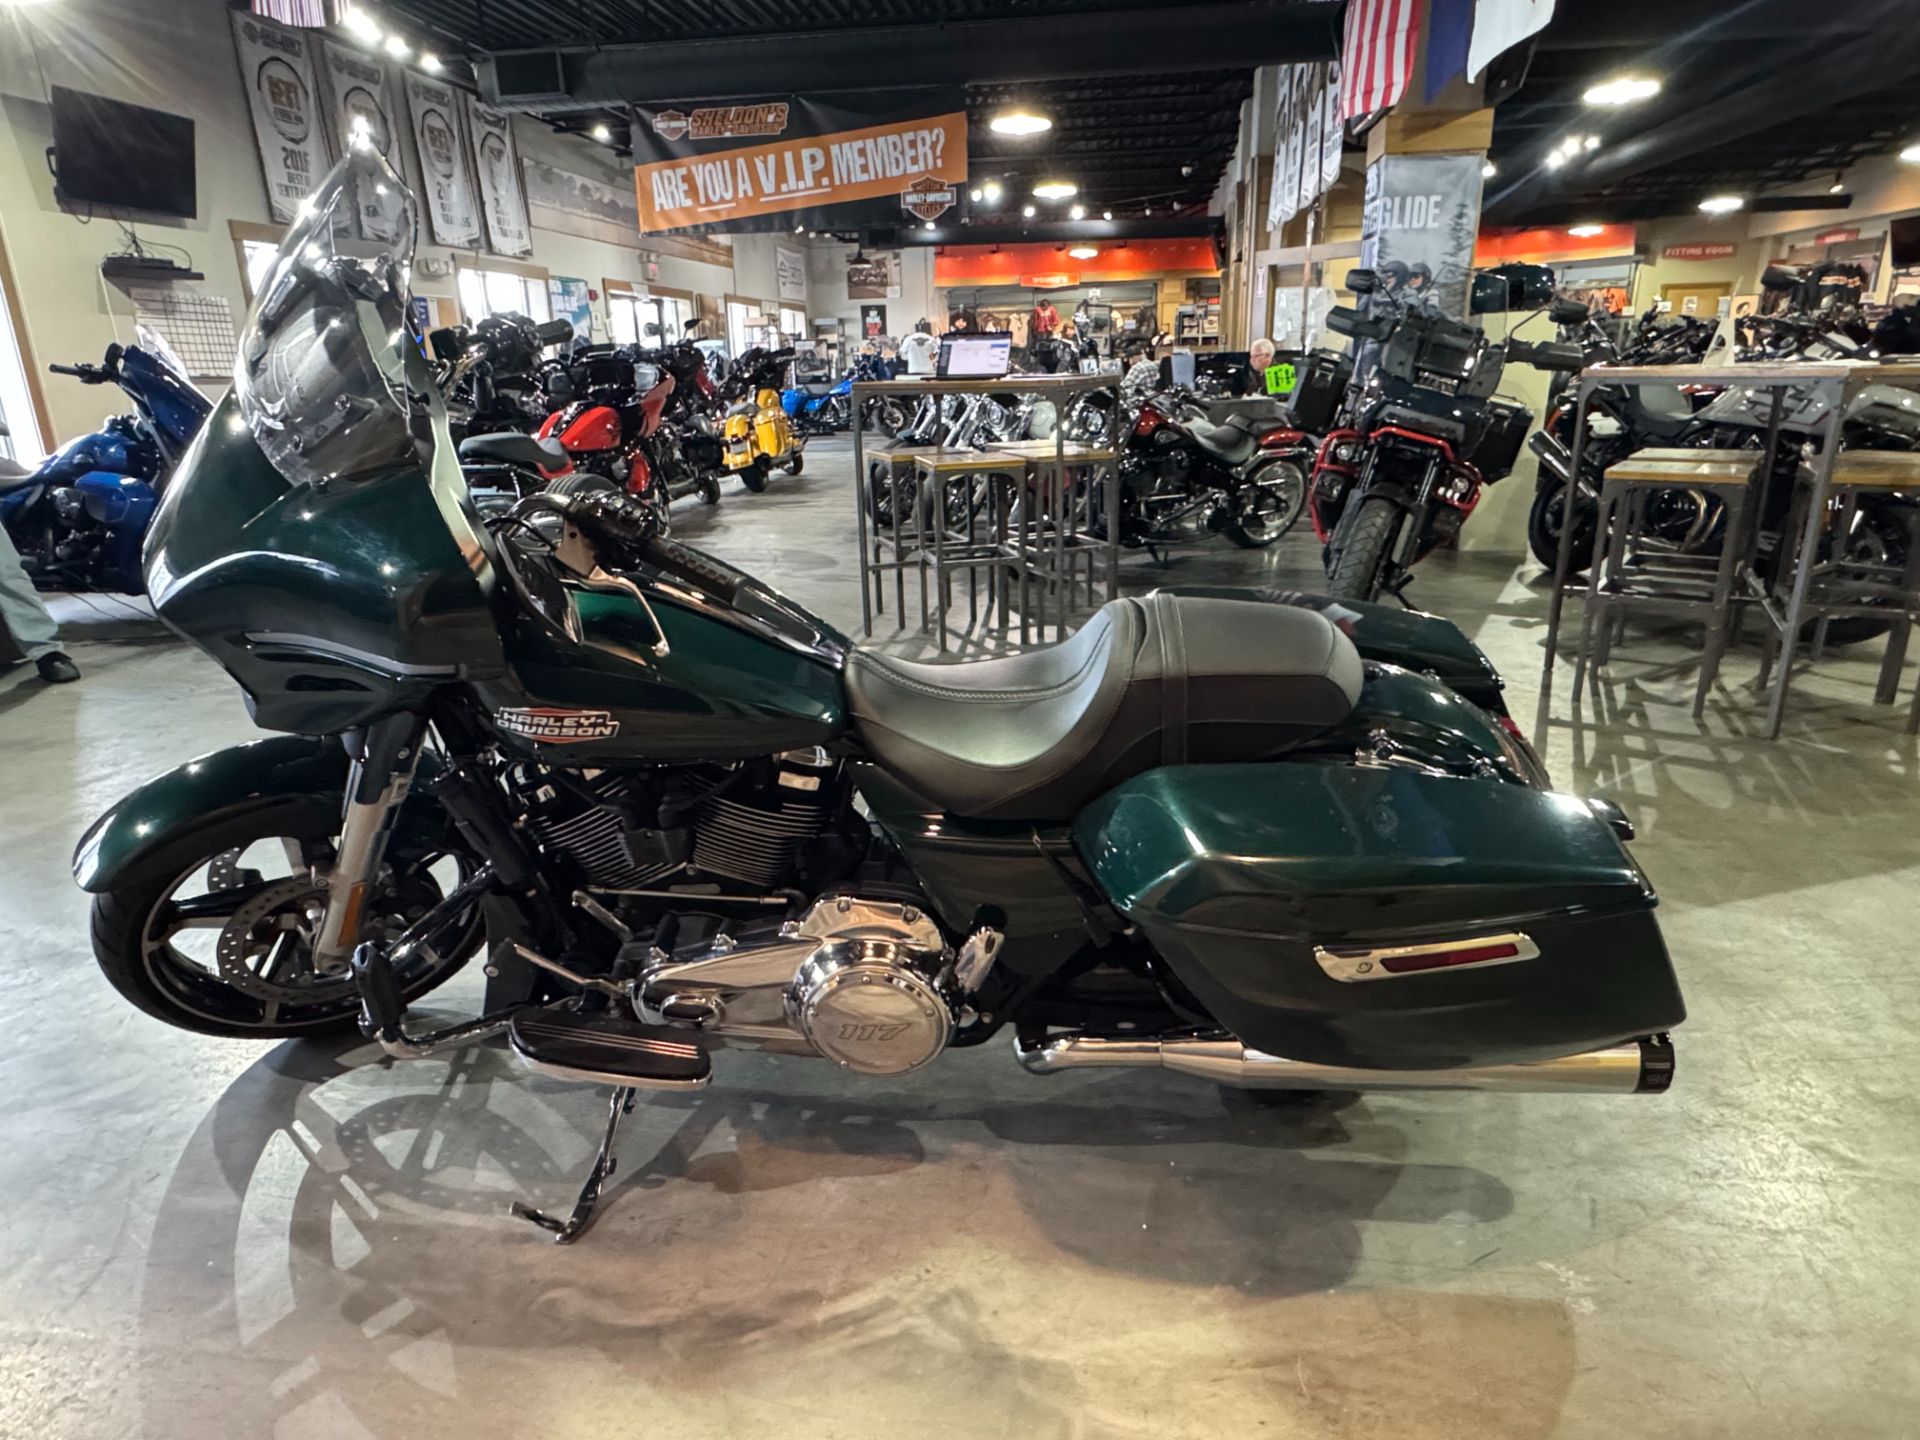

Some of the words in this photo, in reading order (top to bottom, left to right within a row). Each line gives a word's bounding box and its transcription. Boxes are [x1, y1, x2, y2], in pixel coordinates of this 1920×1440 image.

[691, 105, 786, 126] SHELDON'S
[651, 166, 693, 211] ARE
[690, 159, 733, 204] YOU
[736, 157, 752, 198] A
[754, 147, 829, 194] V.I.P.
[830, 127, 945, 186] MEMBER?
[1379, 195, 1441, 229] GLIDE
[496, 719, 613, 736] DAVIDSON
[503, 712, 604, 727] HARLEY-
[838, 1023, 912, 1041] 117
